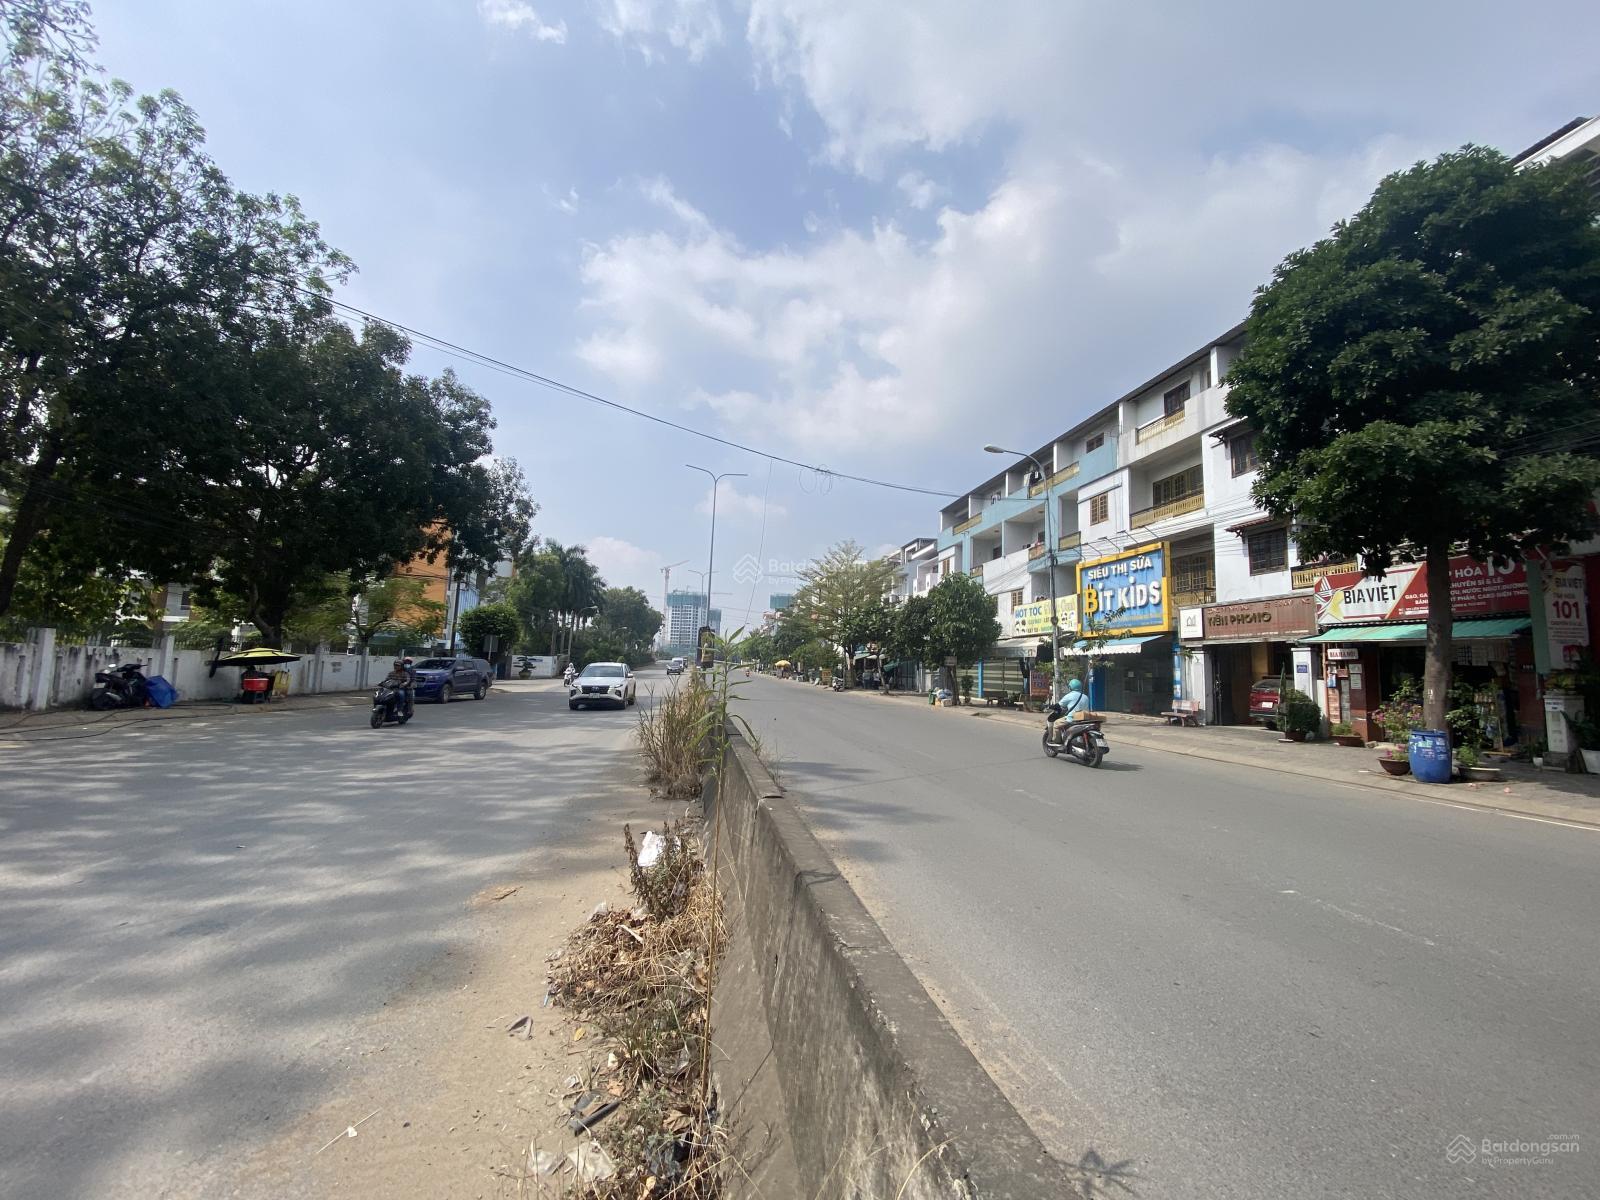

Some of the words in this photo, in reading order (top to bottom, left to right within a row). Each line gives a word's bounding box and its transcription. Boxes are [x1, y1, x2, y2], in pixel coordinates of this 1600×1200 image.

[1111, 562, 1128, 576] THỊ
[1130, 555, 1152, 571] SỮA
[1343, 589, 1366, 605] BIA
[1366, 584, 1398, 604] VIỆT
[1552, 600, 1580, 619] 101
